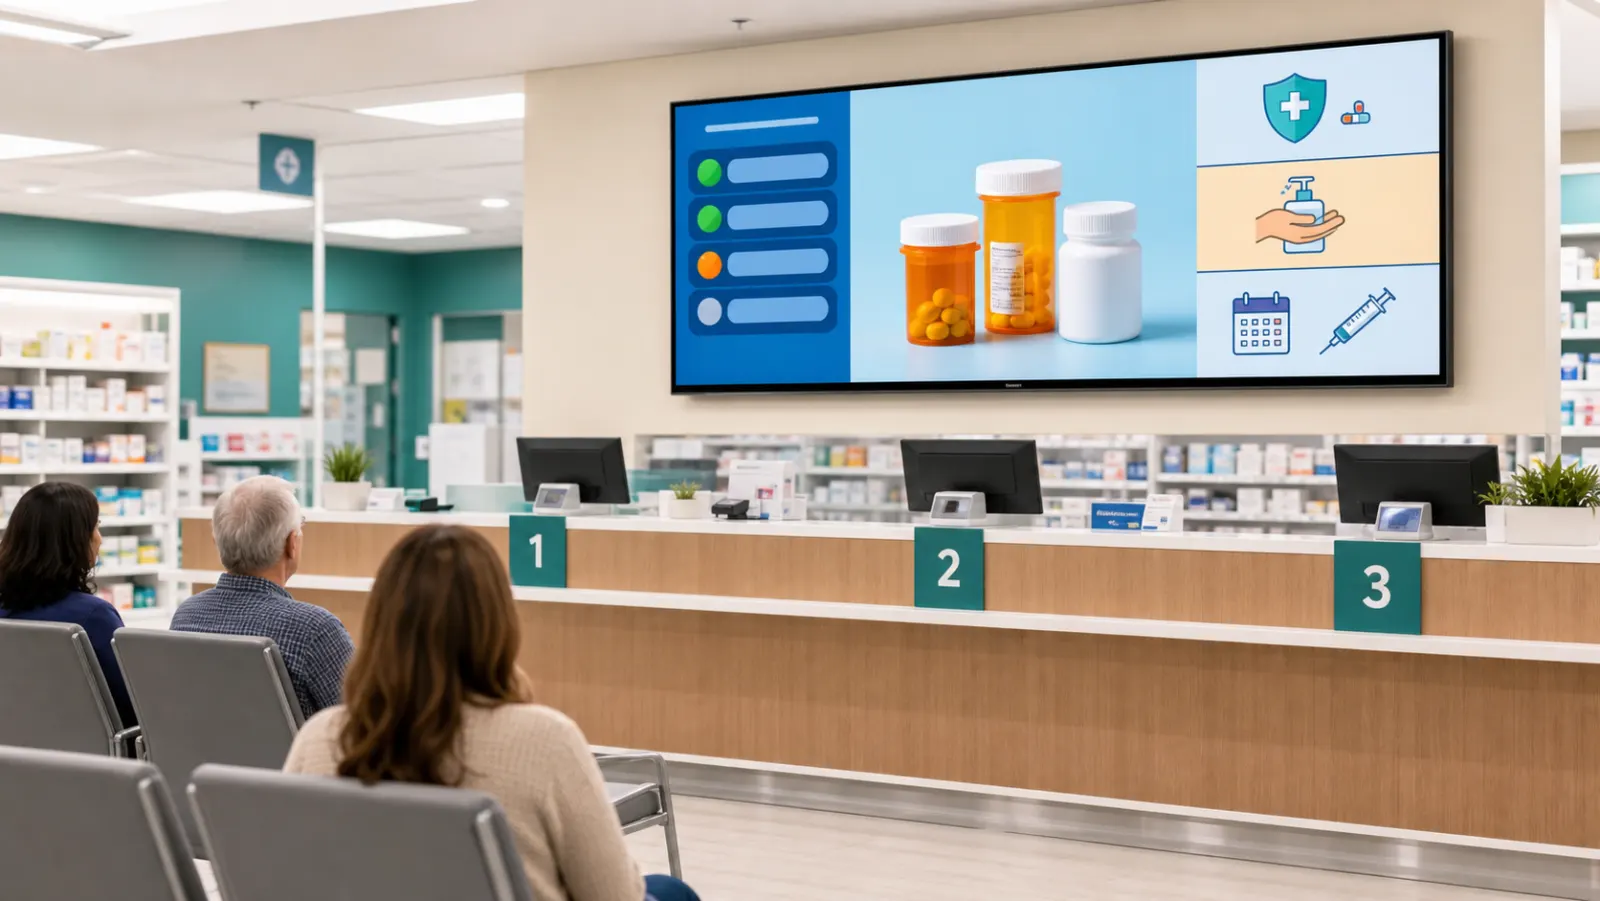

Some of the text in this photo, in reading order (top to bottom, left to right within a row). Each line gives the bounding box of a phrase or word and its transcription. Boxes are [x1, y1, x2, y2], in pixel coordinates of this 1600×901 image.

[528, 533, 543, 568] 1
[938, 548, 961, 588] 2
[1362, 565, 1391, 609] 3
